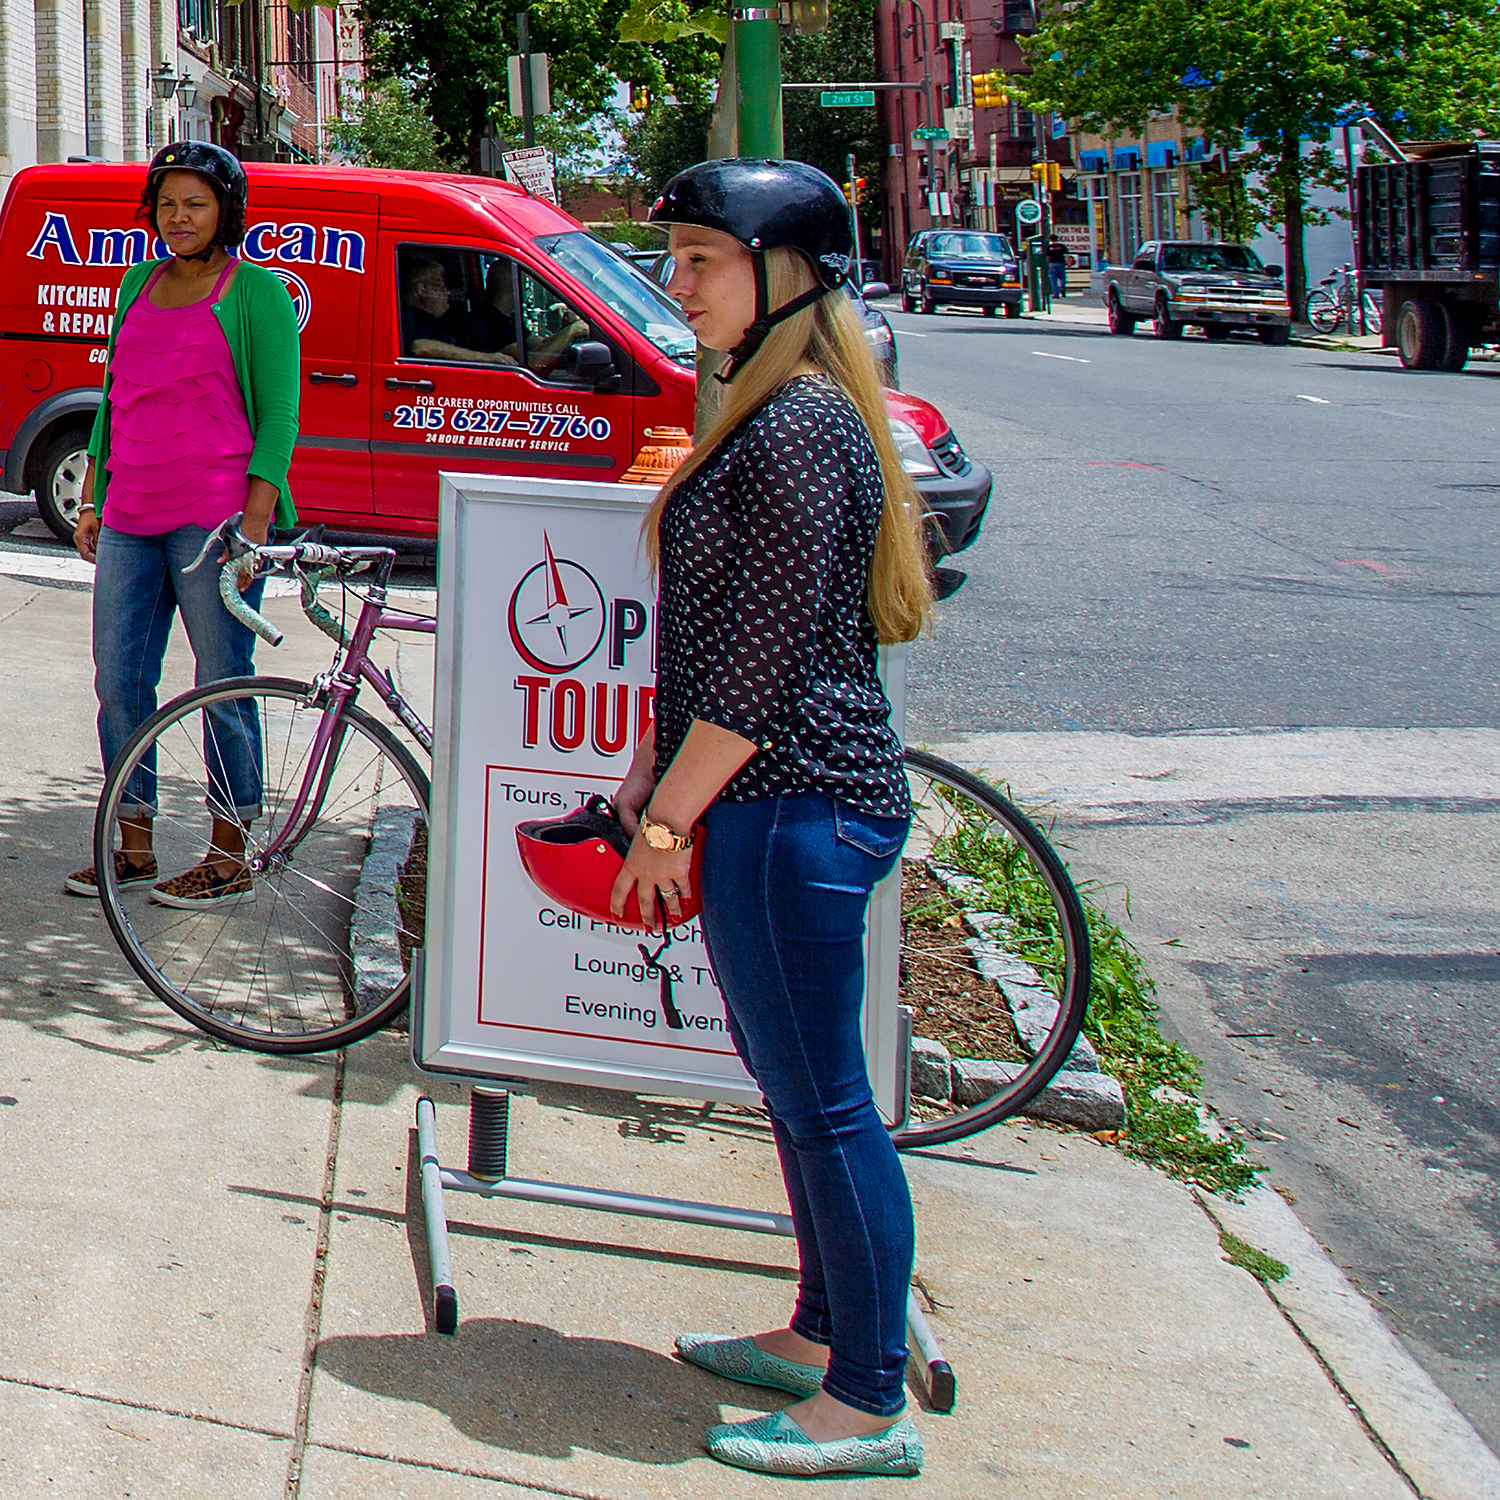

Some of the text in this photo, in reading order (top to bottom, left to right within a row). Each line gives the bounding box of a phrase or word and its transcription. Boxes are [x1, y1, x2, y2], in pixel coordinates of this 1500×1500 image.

[832, 94, 863, 104] 2nd St
[1070, 226, 1082, 234] THE
[27, 212, 365, 274] Amcan
[37, 285, 111, 308] KITCHEN
[43, 312, 56, 332] &
[89, 349, 109, 364] CO
[416, 396, 580, 415] FOR CAREER OPPORTUNITIES CALL
[393, 405, 444, 429] 215
[468, 436, 527, 449] EMERGENCY
[529, 439, 570, 451] SERVICE
[609, 597, 659, 672] P
[501, 783, 567, 809] Tours,
[539, 908, 580, 930] Cell
[574, 952, 659, 982] Lounge
[669, 965, 684, 983] &
[565, 995, 730, 1033] Evening ven
